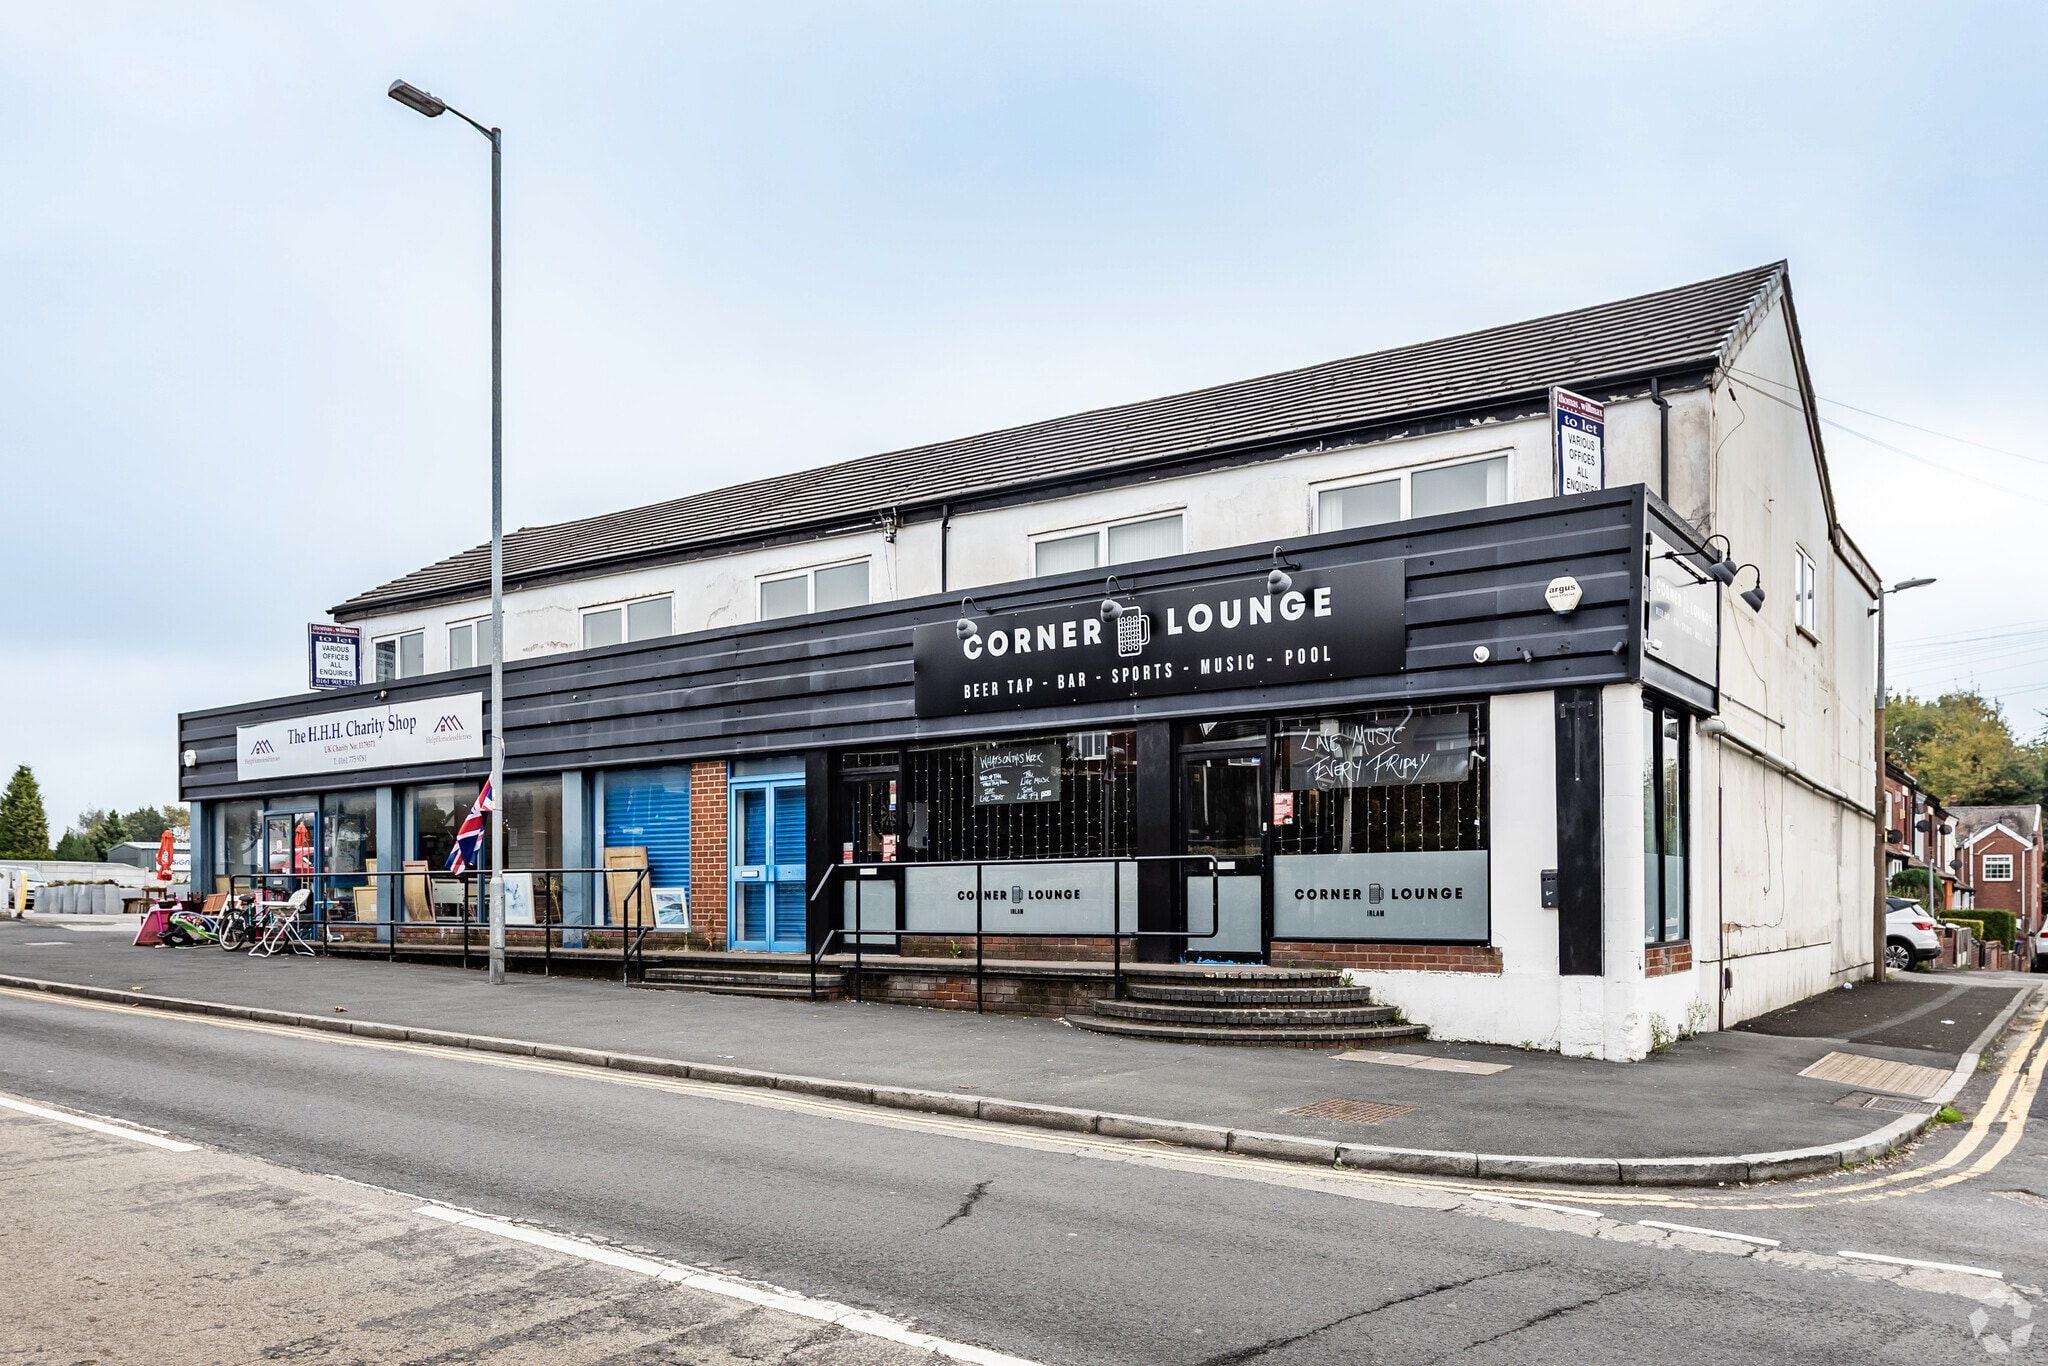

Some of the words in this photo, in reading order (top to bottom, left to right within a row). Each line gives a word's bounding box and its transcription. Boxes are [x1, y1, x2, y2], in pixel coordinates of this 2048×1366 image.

[1564, 415, 1578, 428] to
[1581, 418, 1598, 435] let
[1567, 432, 1595, 451] VARIOUS
[1568, 448, 1596, 466] OFFICES
[1576, 465, 1589, 479] ALL
[1549, 584, 1576, 594] argus
[963, 618, 1102, 660] CORNER
[1167, 586, 1332, 636] LOUNGE
[336, 636, 352, 644] let
[322, 645, 350, 653] VARIOUS
[322, 653, 350, 661] OFFICES
[330, 661, 342, 669] ALL
[319, 668, 353, 678] ENQUIRIES
[964, 681, 999, 699] BEER
[1007, 677, 1033, 694] TAP
[1057, 671, 1086, 689] BAR
[1111, 662, 1172, 684] SPORTS
[1200, 653, 1255, 675] MUSIC
[1285, 645, 1331, 666] POOL
[287, 728, 307, 745] The
[308, 722, 344, 743] H.H.H.
[346, 716, 385, 739] Charity
[388, 713, 417, 735] Shop
[1352, 724, 1406, 756] MUSIC
[1306, 755, 1362, 785] EVERY
[1365, 745, 1431, 784] FRIDAY
[957, 890, 1007, 901] CONER
[1028, 889, 1080, 900] LOUNGE
[1294, 888, 1362, 900] CORNER
[1391, 887, 1463, 900] LOUNGE
[1366, 909, 1385, 917] IRLAM
